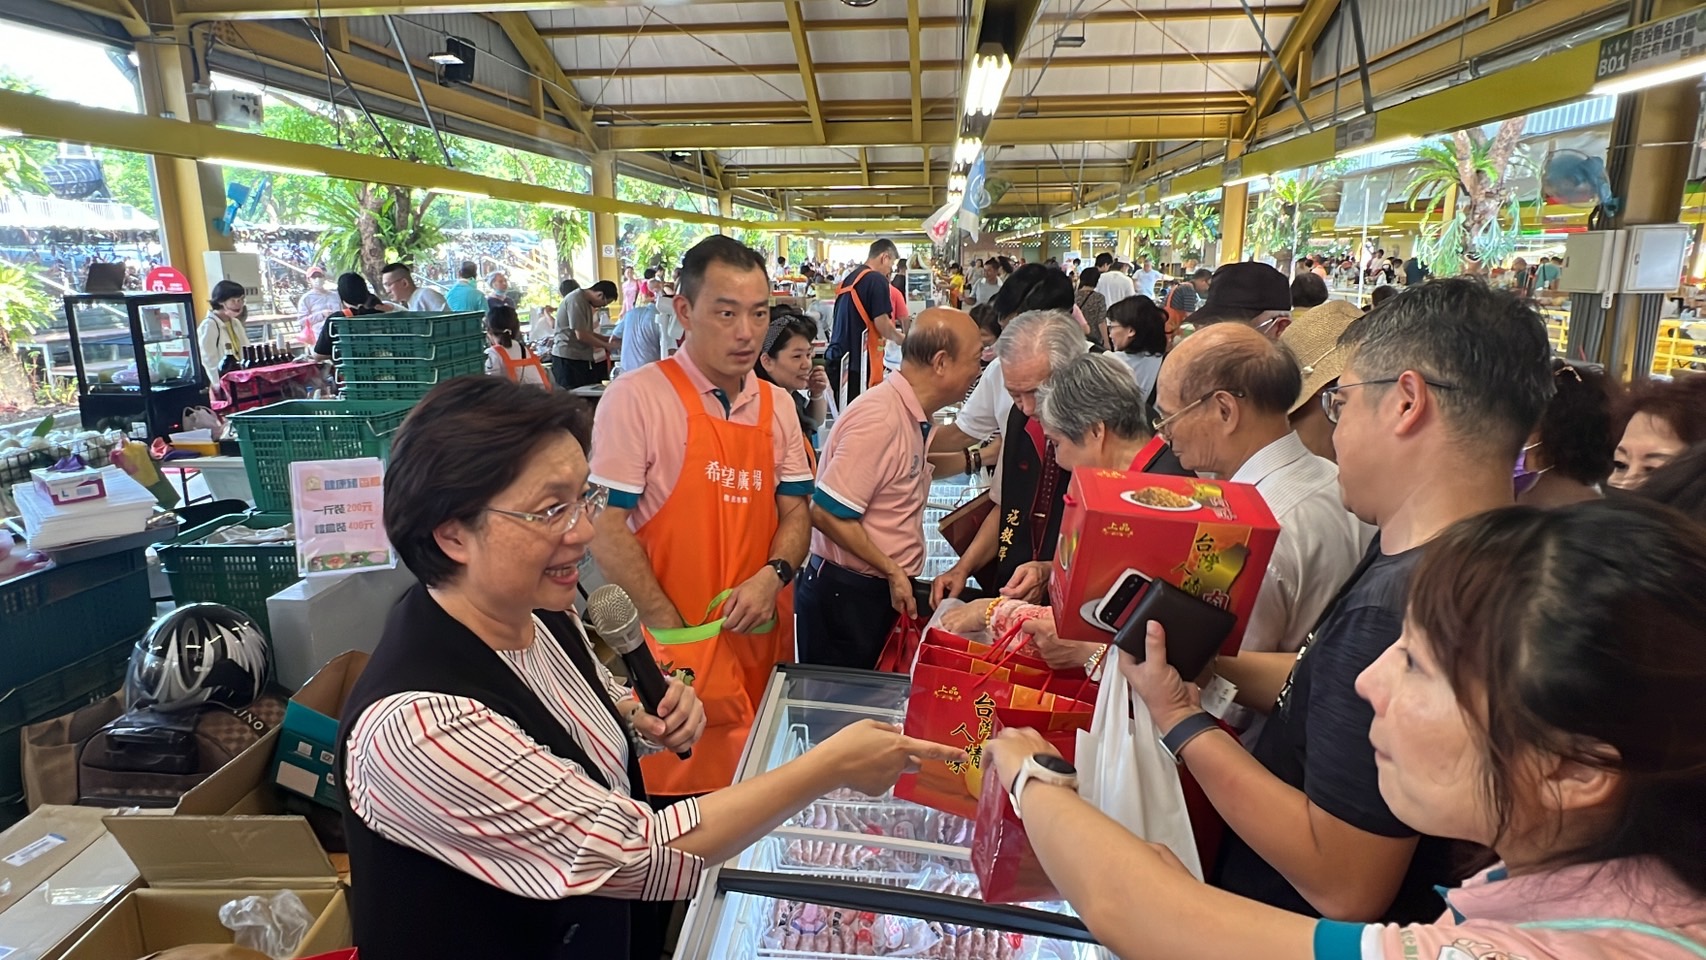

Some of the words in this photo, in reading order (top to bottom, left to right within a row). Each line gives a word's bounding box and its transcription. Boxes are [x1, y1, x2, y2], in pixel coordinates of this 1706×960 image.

[1598, 53, 1626, 76] B01
[705, 460, 762, 491] 希望廣場
[233, 710, 264, 730] INO
